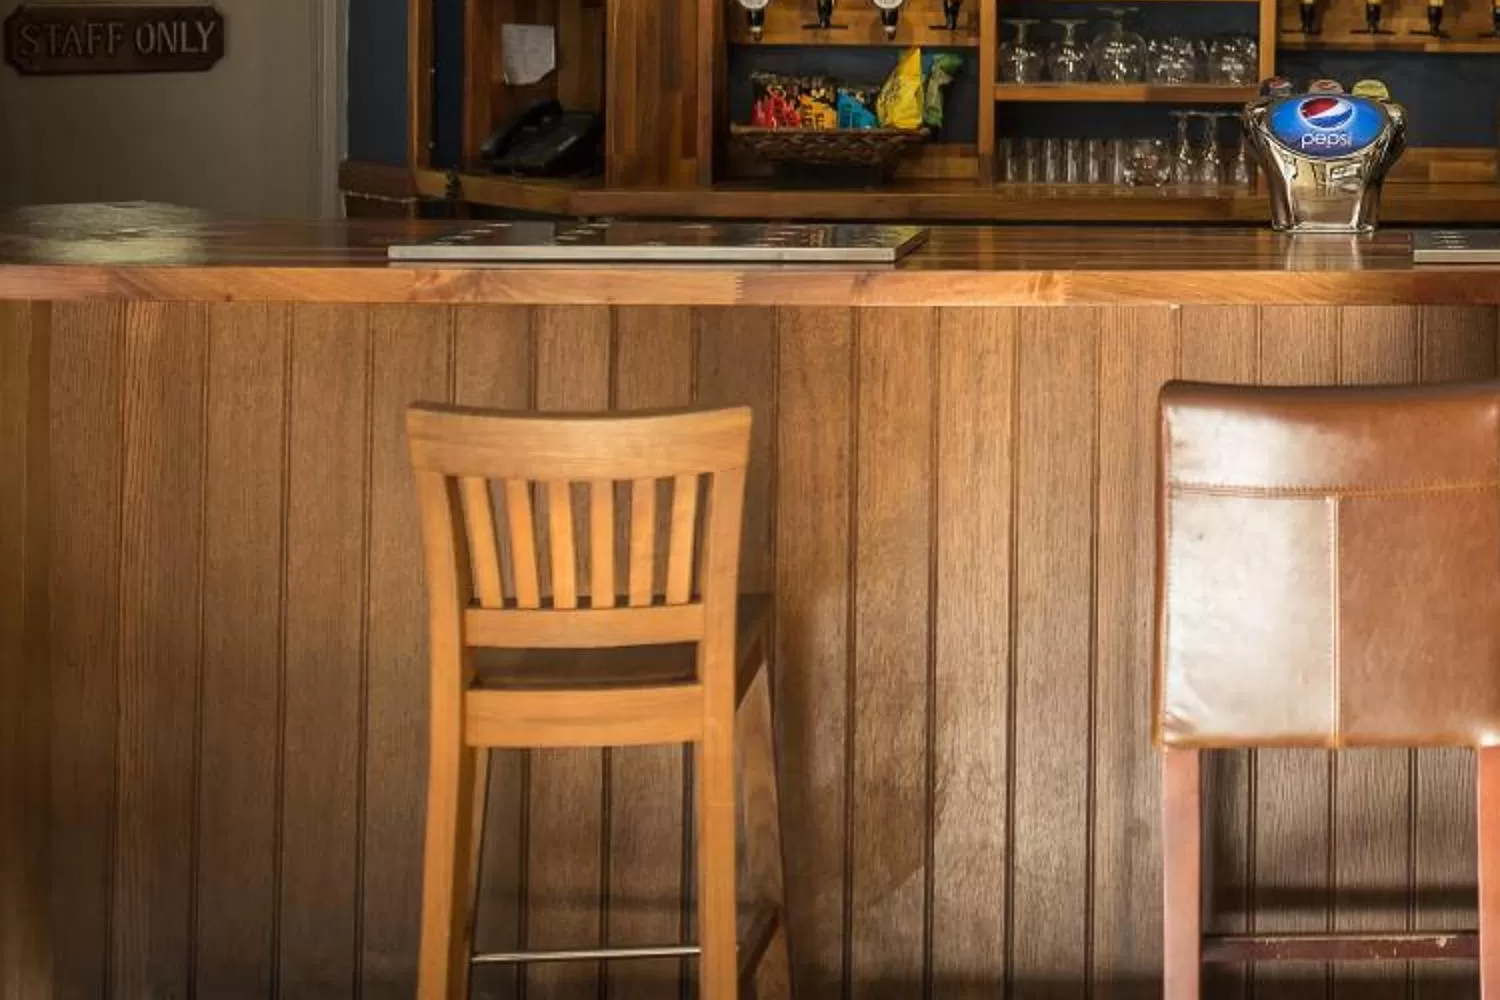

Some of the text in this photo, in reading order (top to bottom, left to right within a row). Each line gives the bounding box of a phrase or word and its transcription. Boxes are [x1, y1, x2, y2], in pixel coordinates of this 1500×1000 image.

[20, 20, 216, 56] STAFF ONLY
[1302, 133, 1353, 149] pepsi
